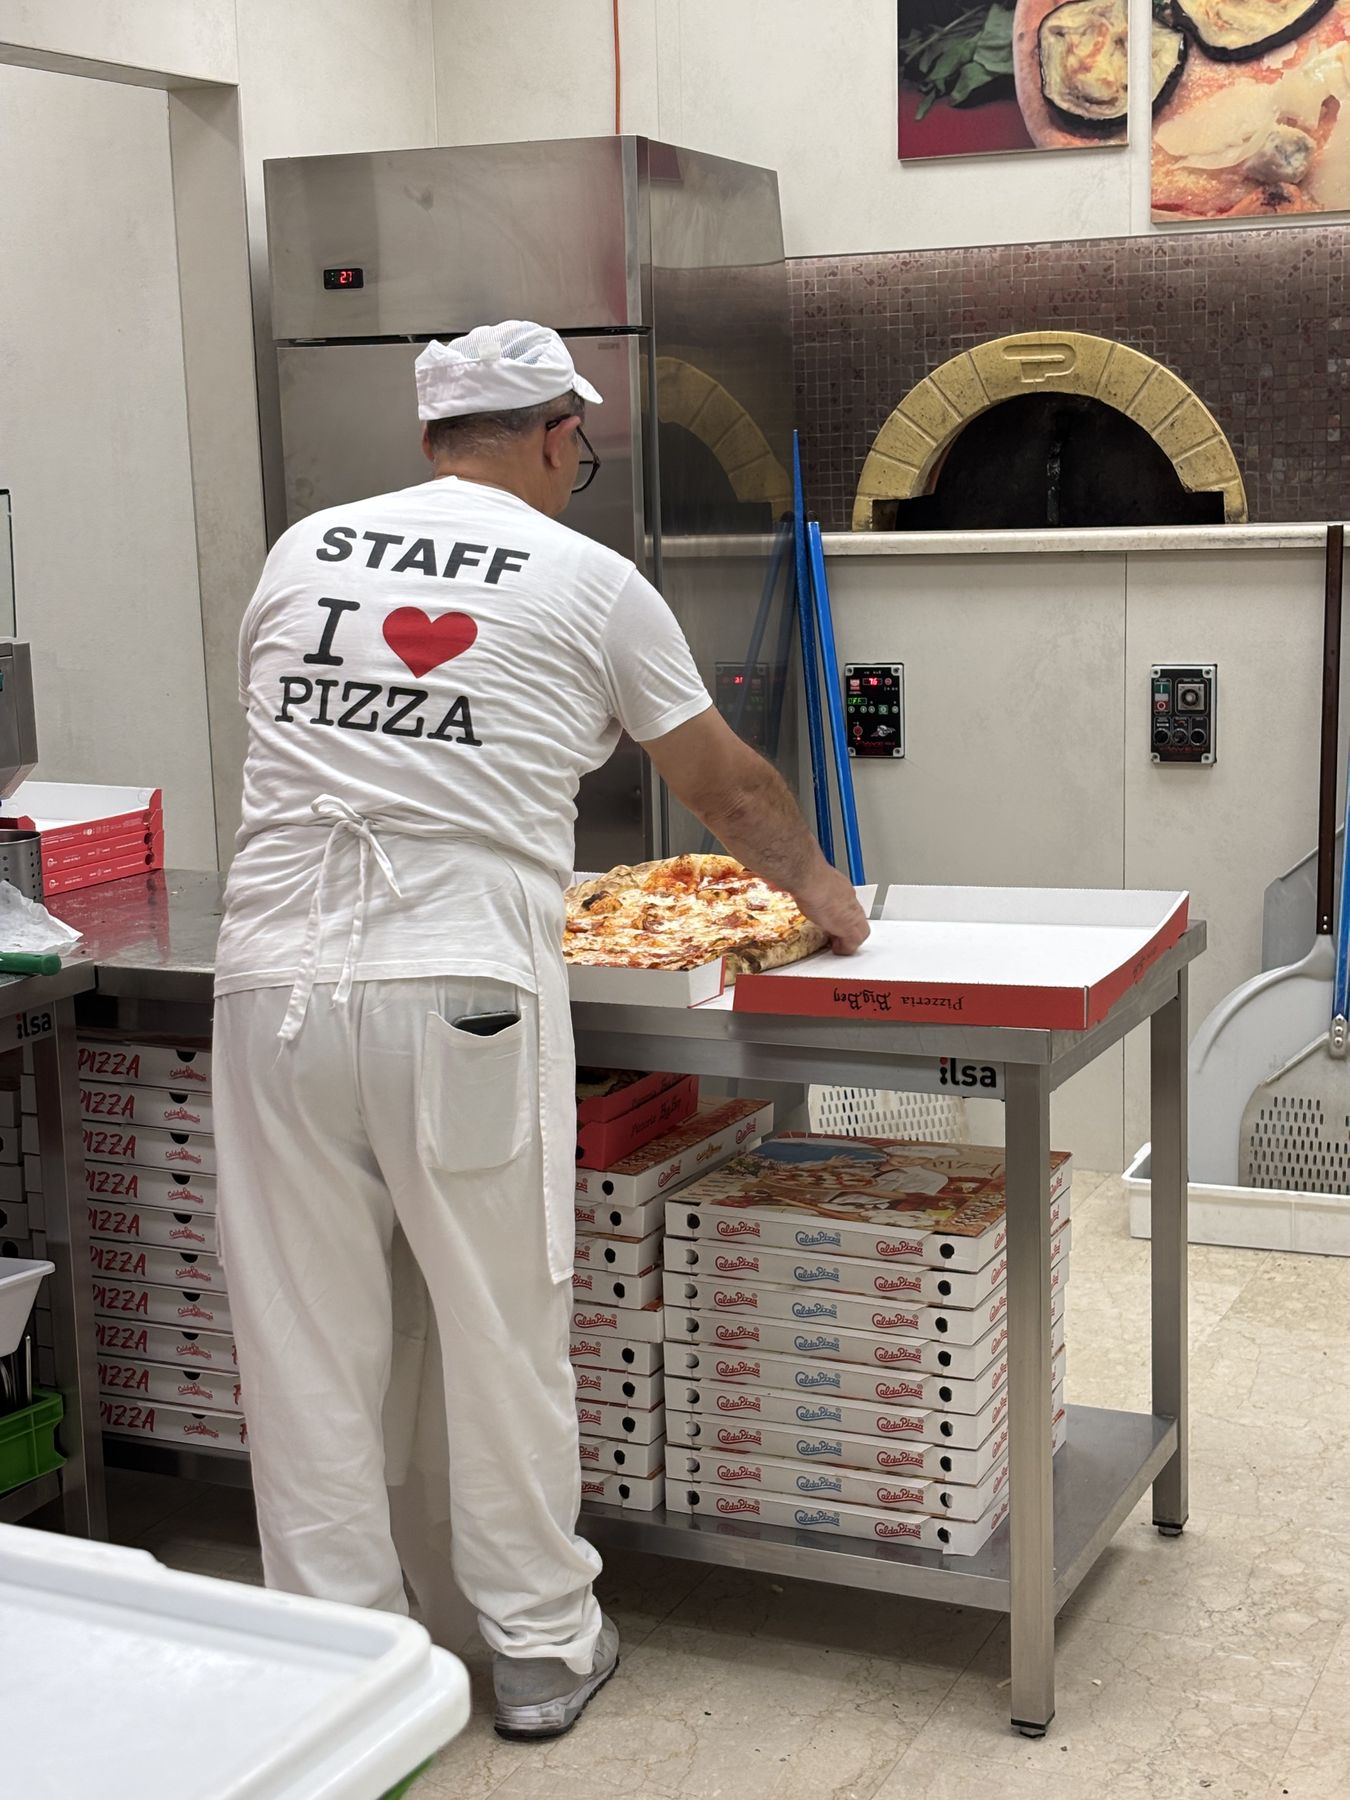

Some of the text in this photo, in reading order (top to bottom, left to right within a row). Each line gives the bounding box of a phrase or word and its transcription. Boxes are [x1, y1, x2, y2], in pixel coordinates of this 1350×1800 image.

[316, 526, 530, 584] STAFF
[303, 597, 360, 666] I
[274, 676, 483, 747] PIZZA
[901, 996, 965, 1011] Pizzeria
[16, 1012, 51, 1039] ilsa
[78, 1048, 140, 1079] PIZZA
[940, 1056, 996, 1088] ilsa
